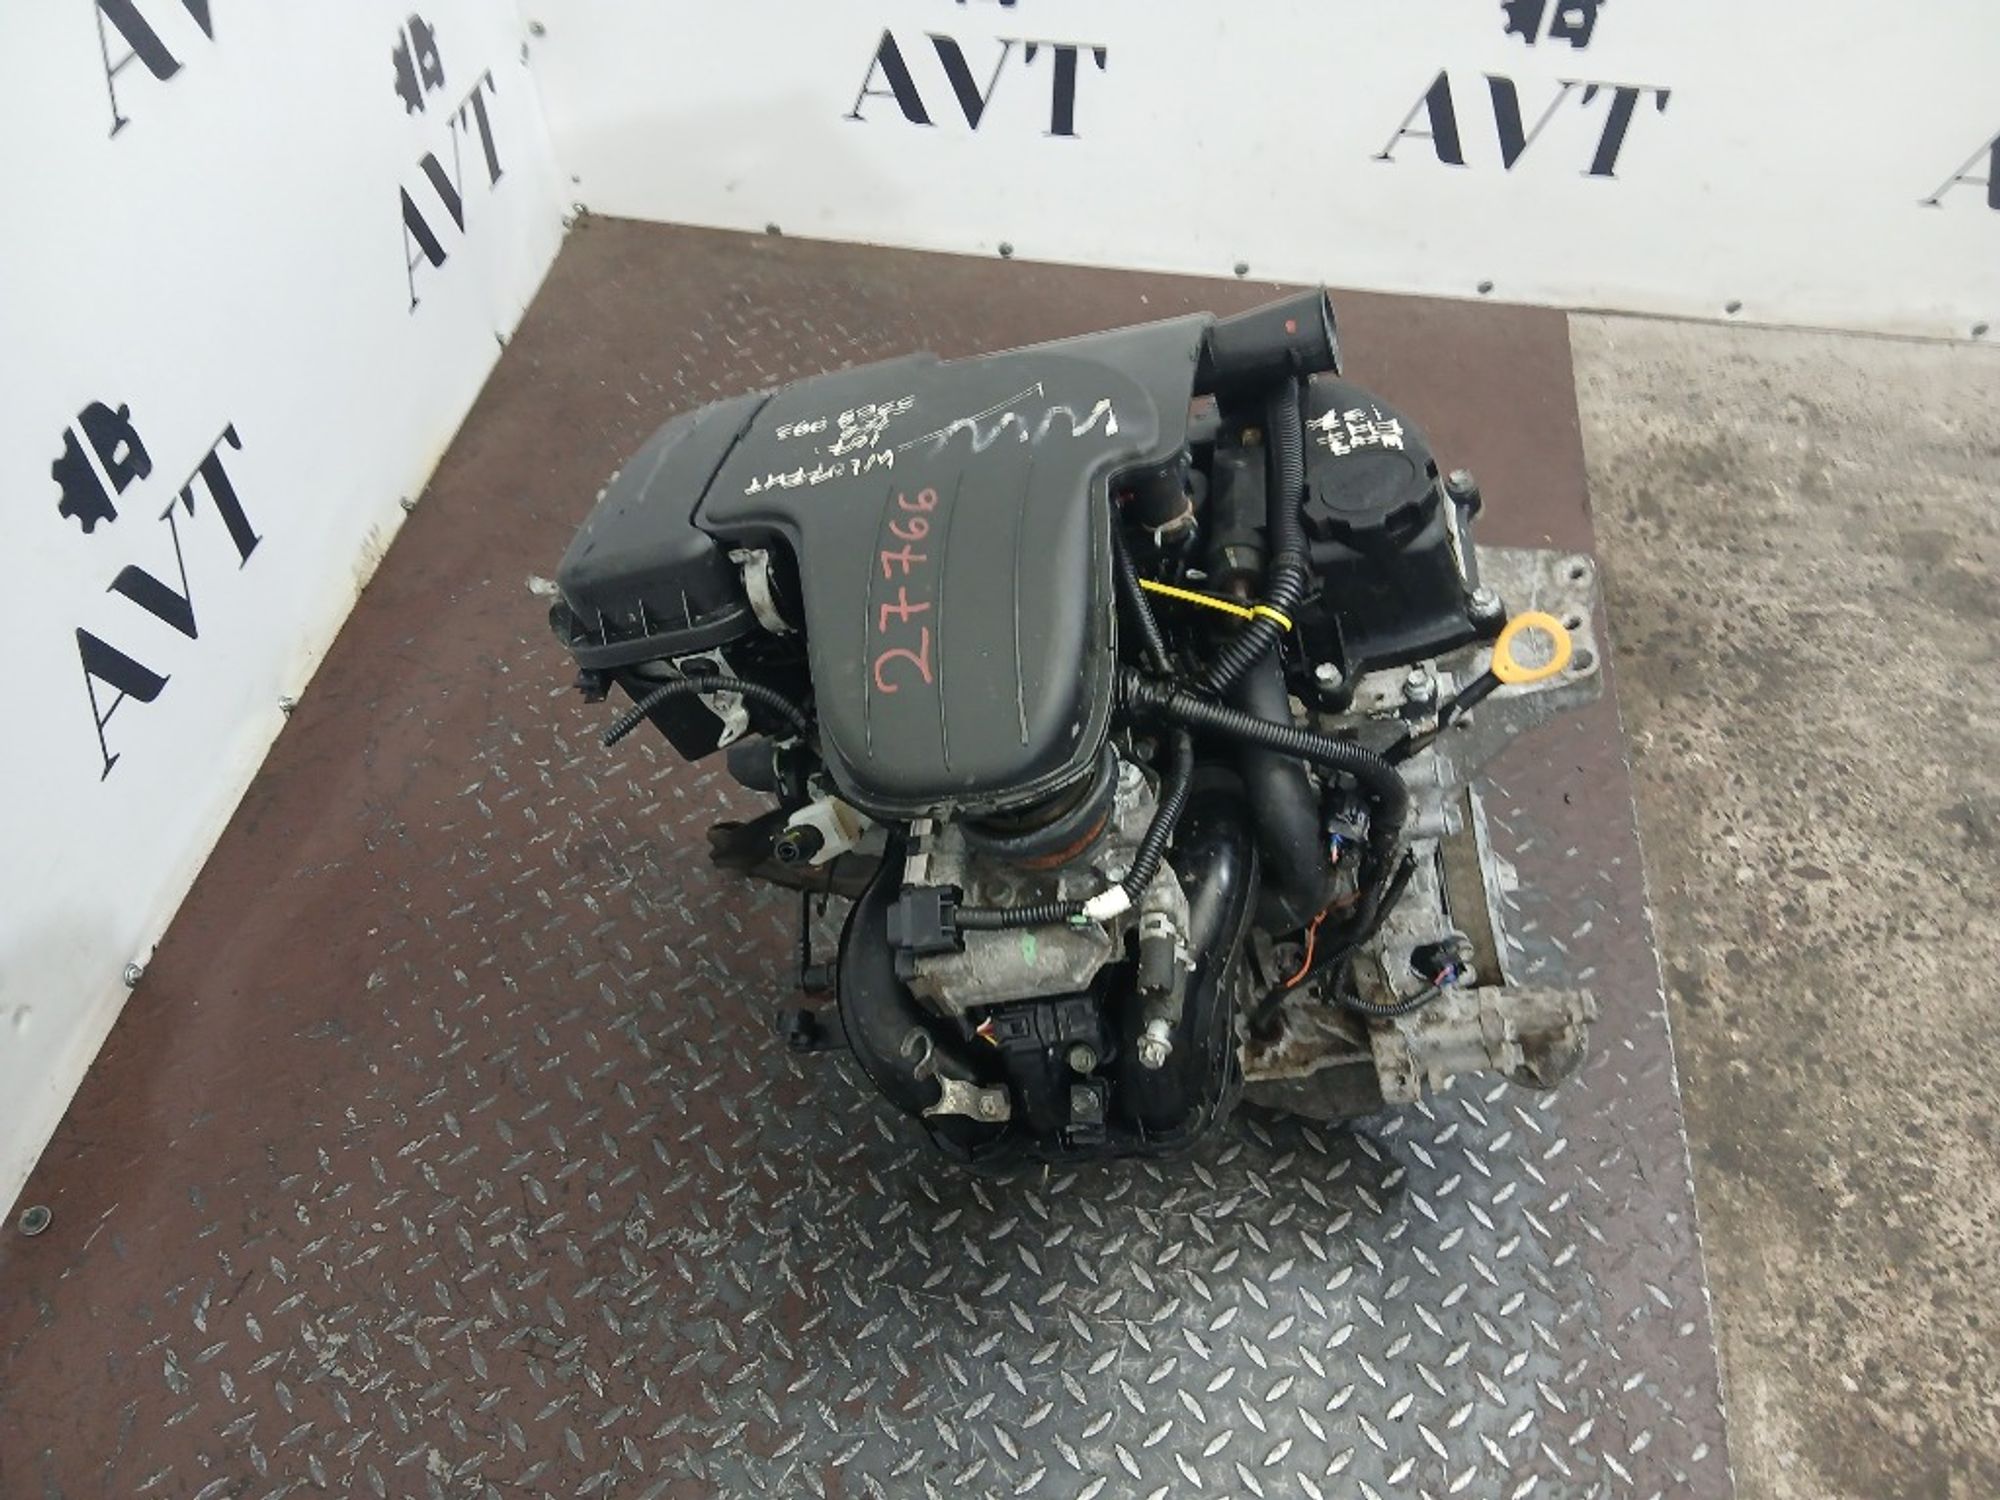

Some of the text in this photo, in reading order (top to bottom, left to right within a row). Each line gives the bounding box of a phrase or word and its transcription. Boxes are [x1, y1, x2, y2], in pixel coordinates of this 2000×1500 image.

[843, 28, 1108, 138] AVT
[1369, 68, 1672, 179] AVT
[399, 69, 503, 315] AVT
[75, 422, 263, 782] AVT
[874, 488, 939, 694] 27766
